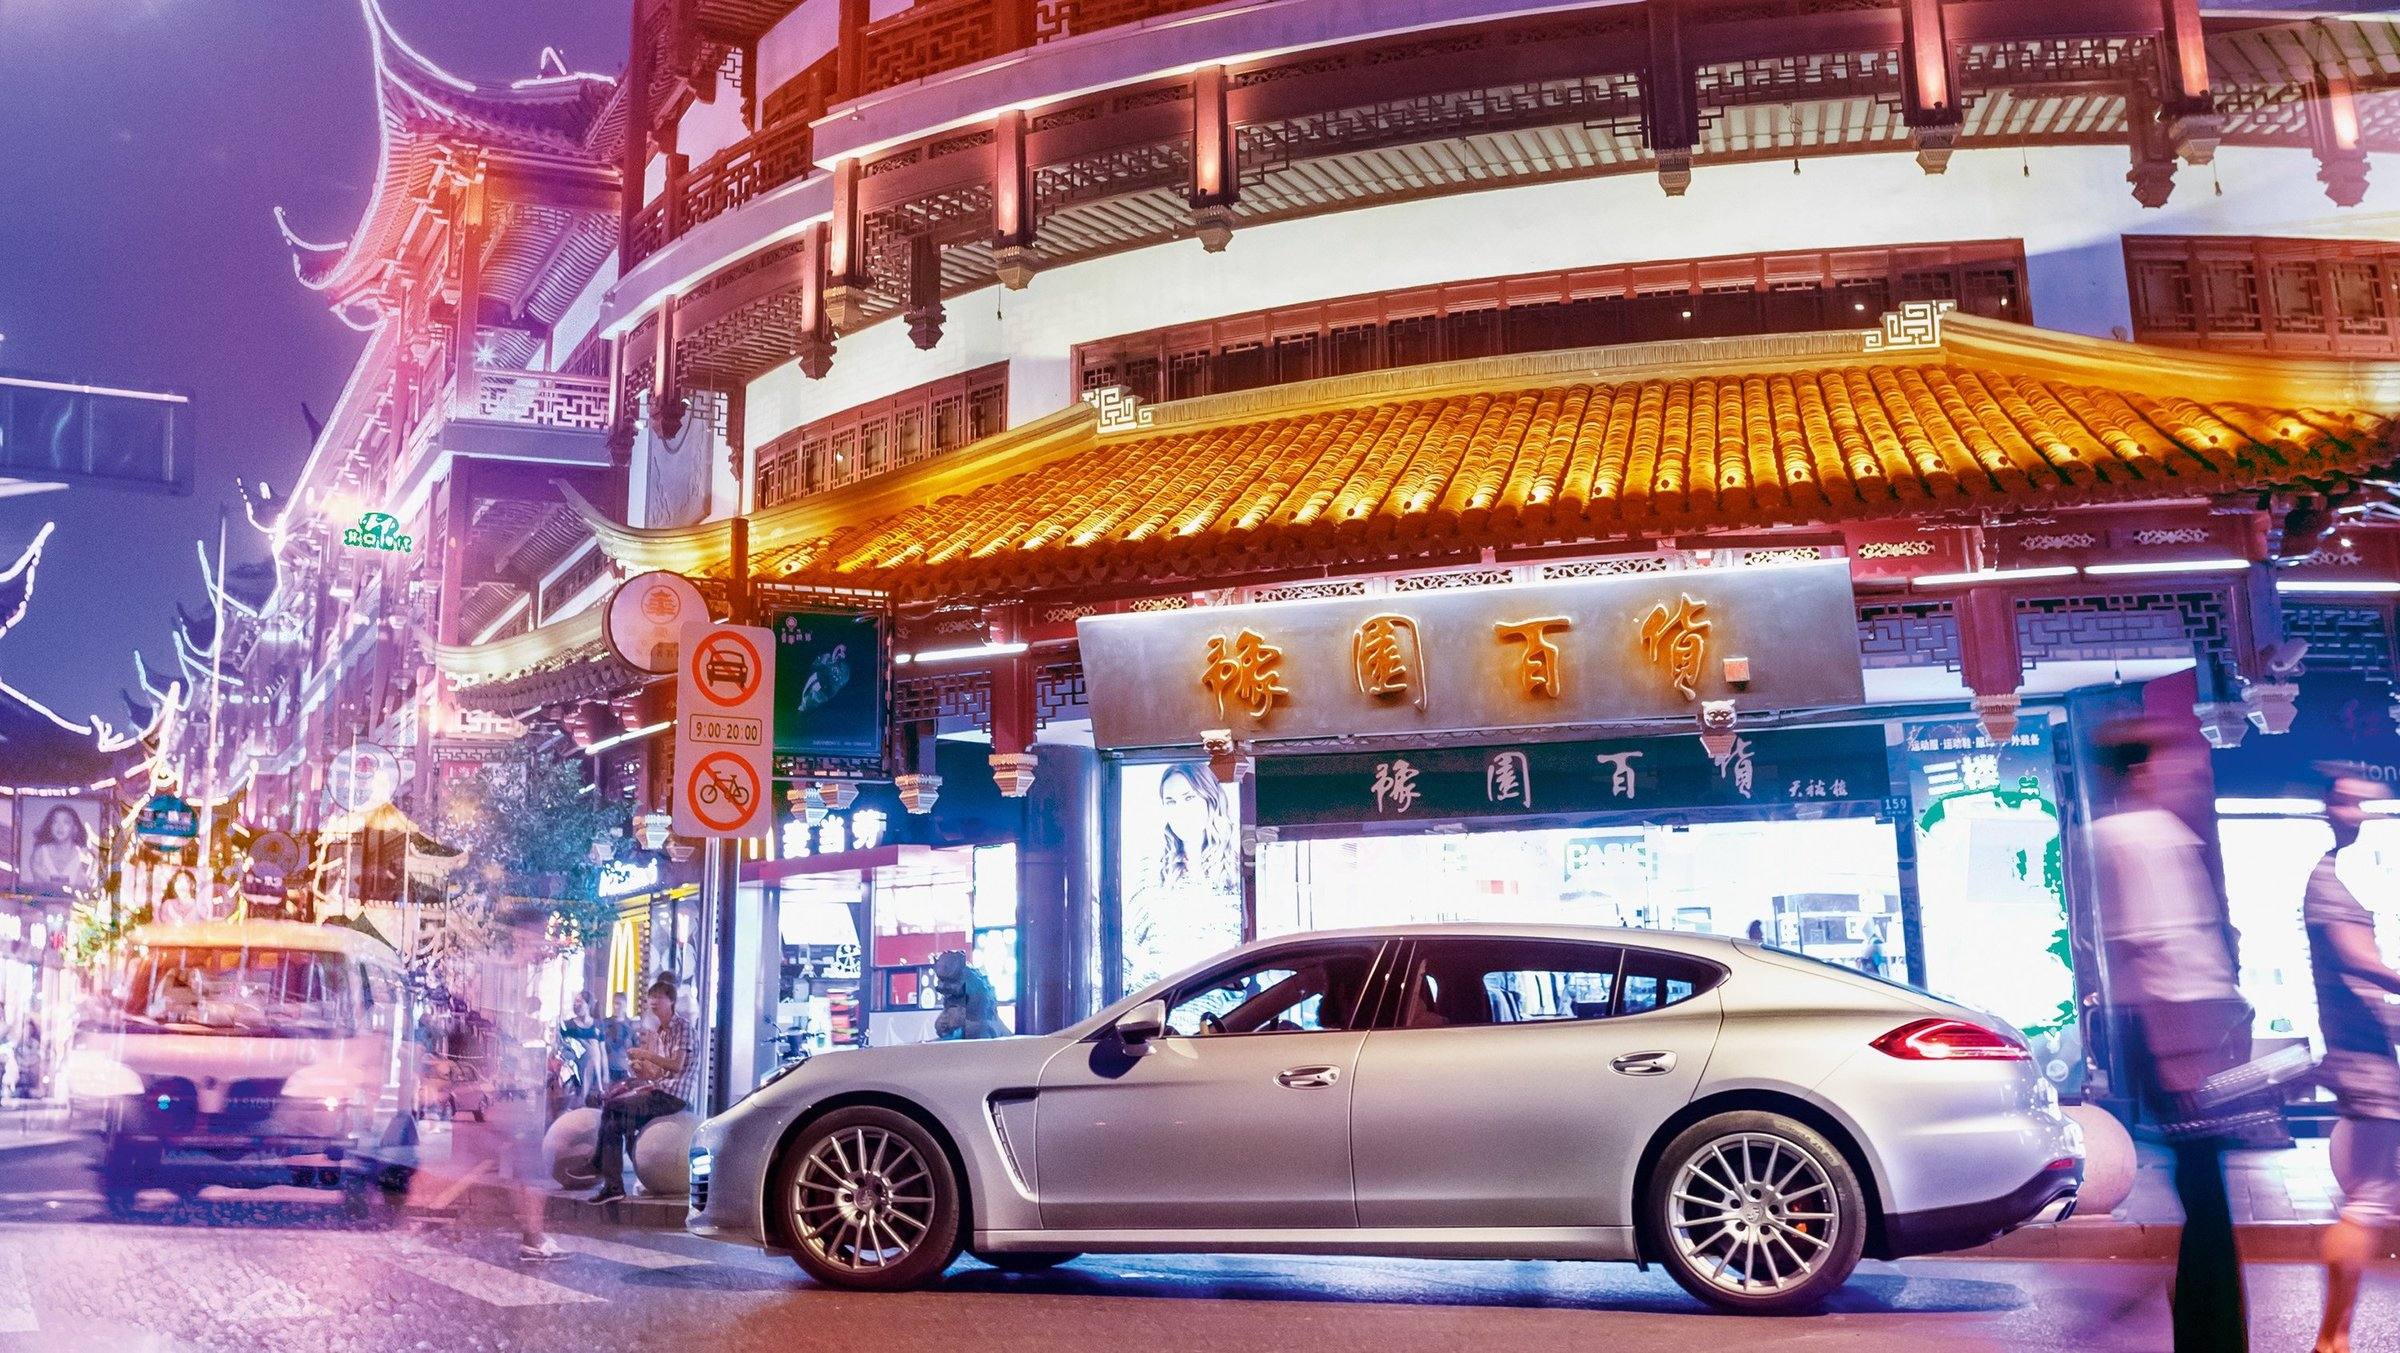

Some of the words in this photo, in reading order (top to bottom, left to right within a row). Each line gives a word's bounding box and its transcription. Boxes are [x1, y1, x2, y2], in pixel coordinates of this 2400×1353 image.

[1200, 592, 1712, 721] 豫園百貨
[696, 721, 758, 741] 9:00-20:00
[1923, 754, 2000, 796] 三楼
[1885, 798, 1907, 809] 159
